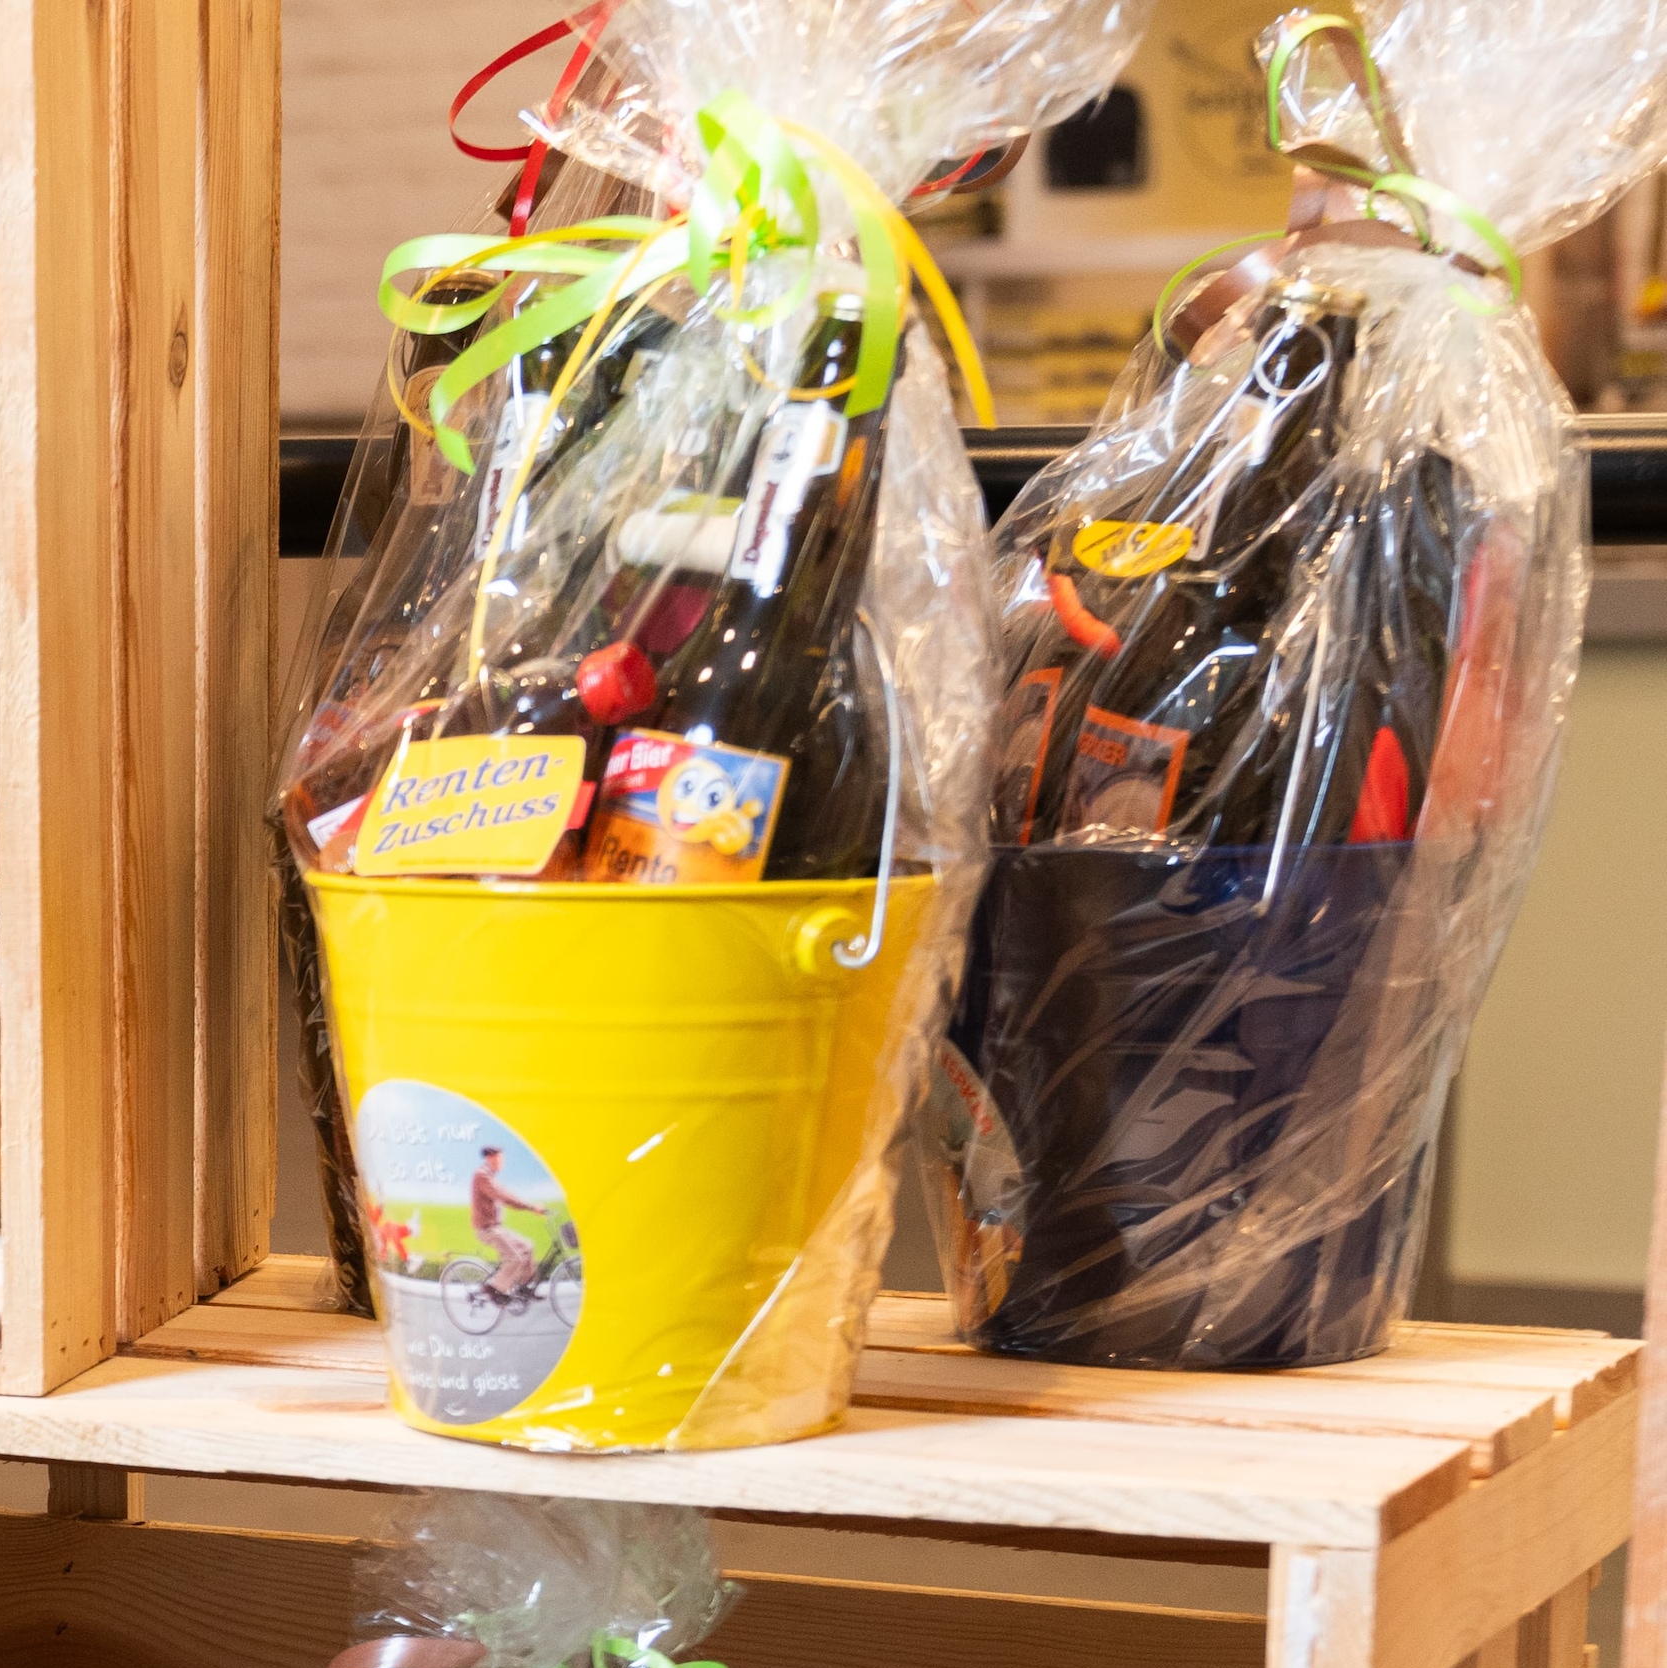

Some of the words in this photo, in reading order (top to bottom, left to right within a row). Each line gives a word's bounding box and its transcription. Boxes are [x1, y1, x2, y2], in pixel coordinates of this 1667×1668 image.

[630, 742, 675, 769] Bier
[386, 750, 564, 818] Renten-
[373, 792, 563, 855] Zuschuss
[437, 1121, 480, 1142] nur
[429, 1334, 453, 1358] Du
[460, 1335, 495, 1360] dich
[473, 1371, 521, 1396] gibst
